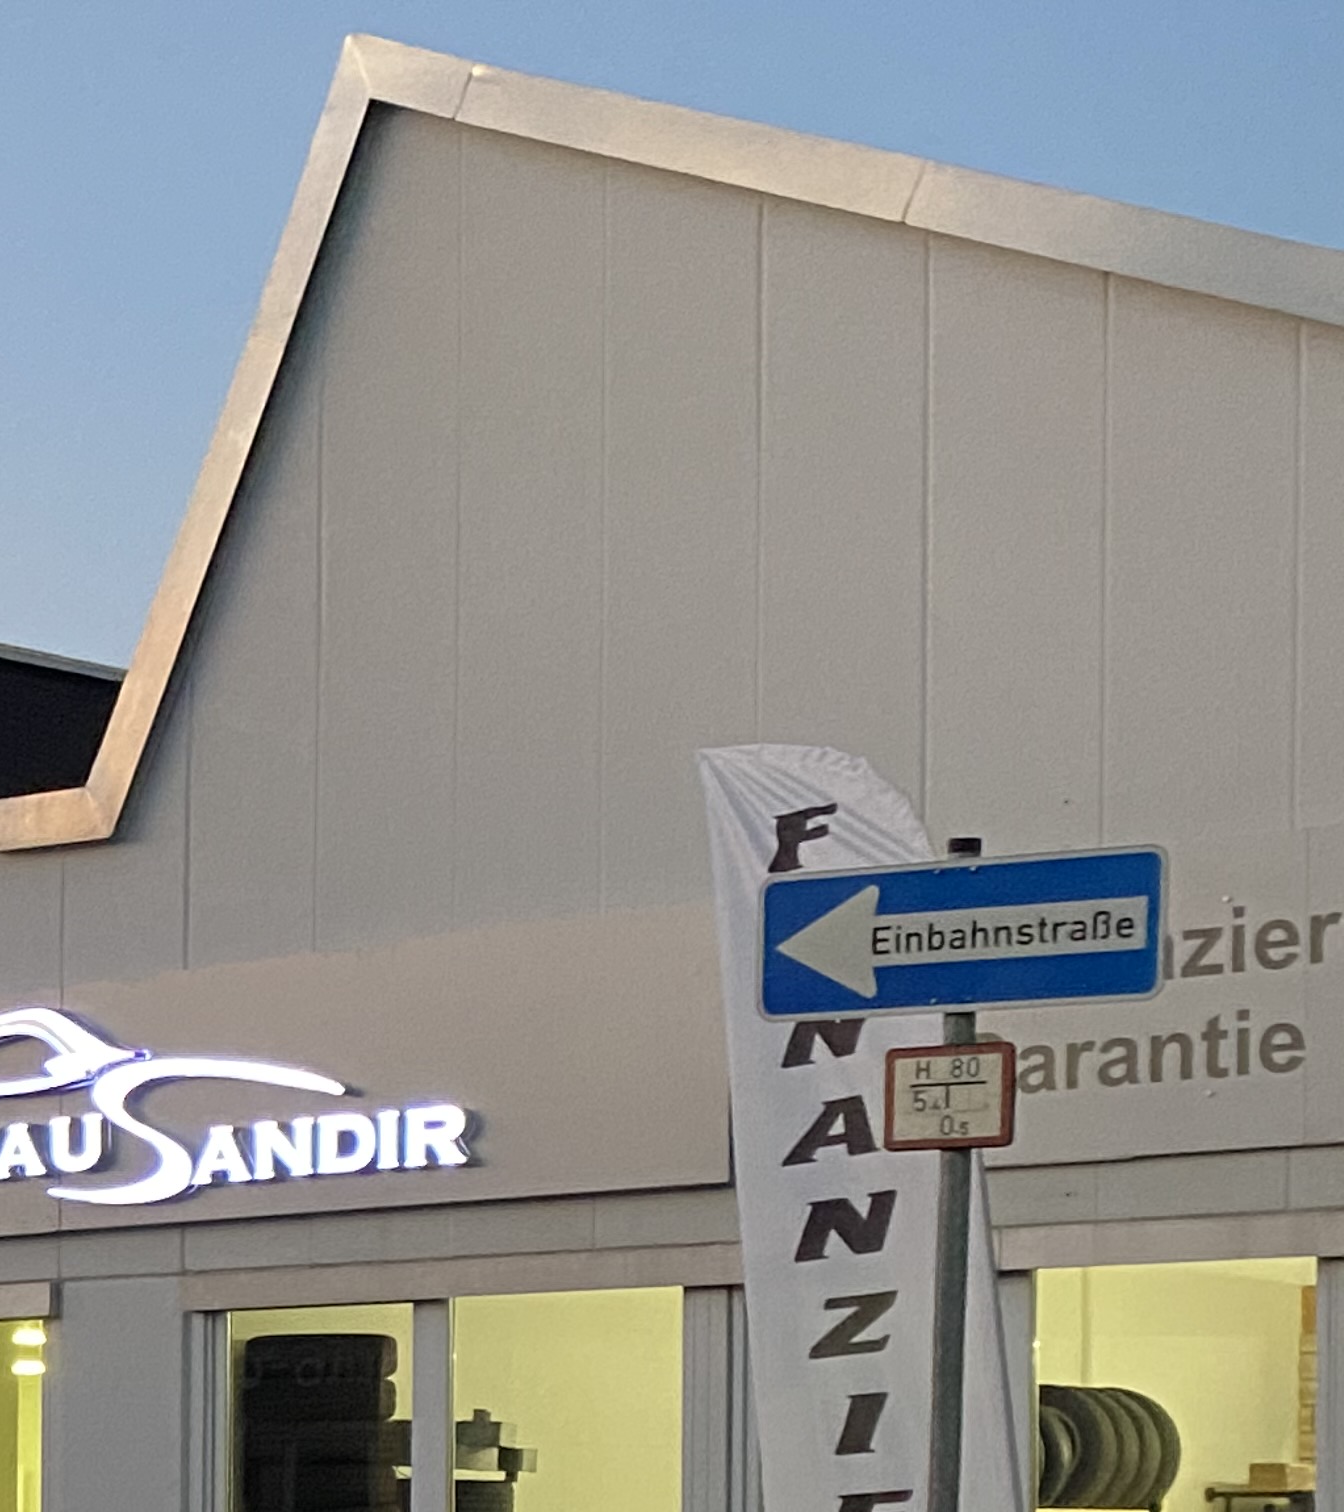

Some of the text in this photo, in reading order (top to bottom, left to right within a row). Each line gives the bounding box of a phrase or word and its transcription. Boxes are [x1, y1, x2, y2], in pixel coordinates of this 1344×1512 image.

[872, 910, 1135, 955] Einbahnstraße
[1164, 905, 1342, 979] zier
[915, 1056, 980, 1079] H 80
[1002, 1009, 1306, 1094] arantie
